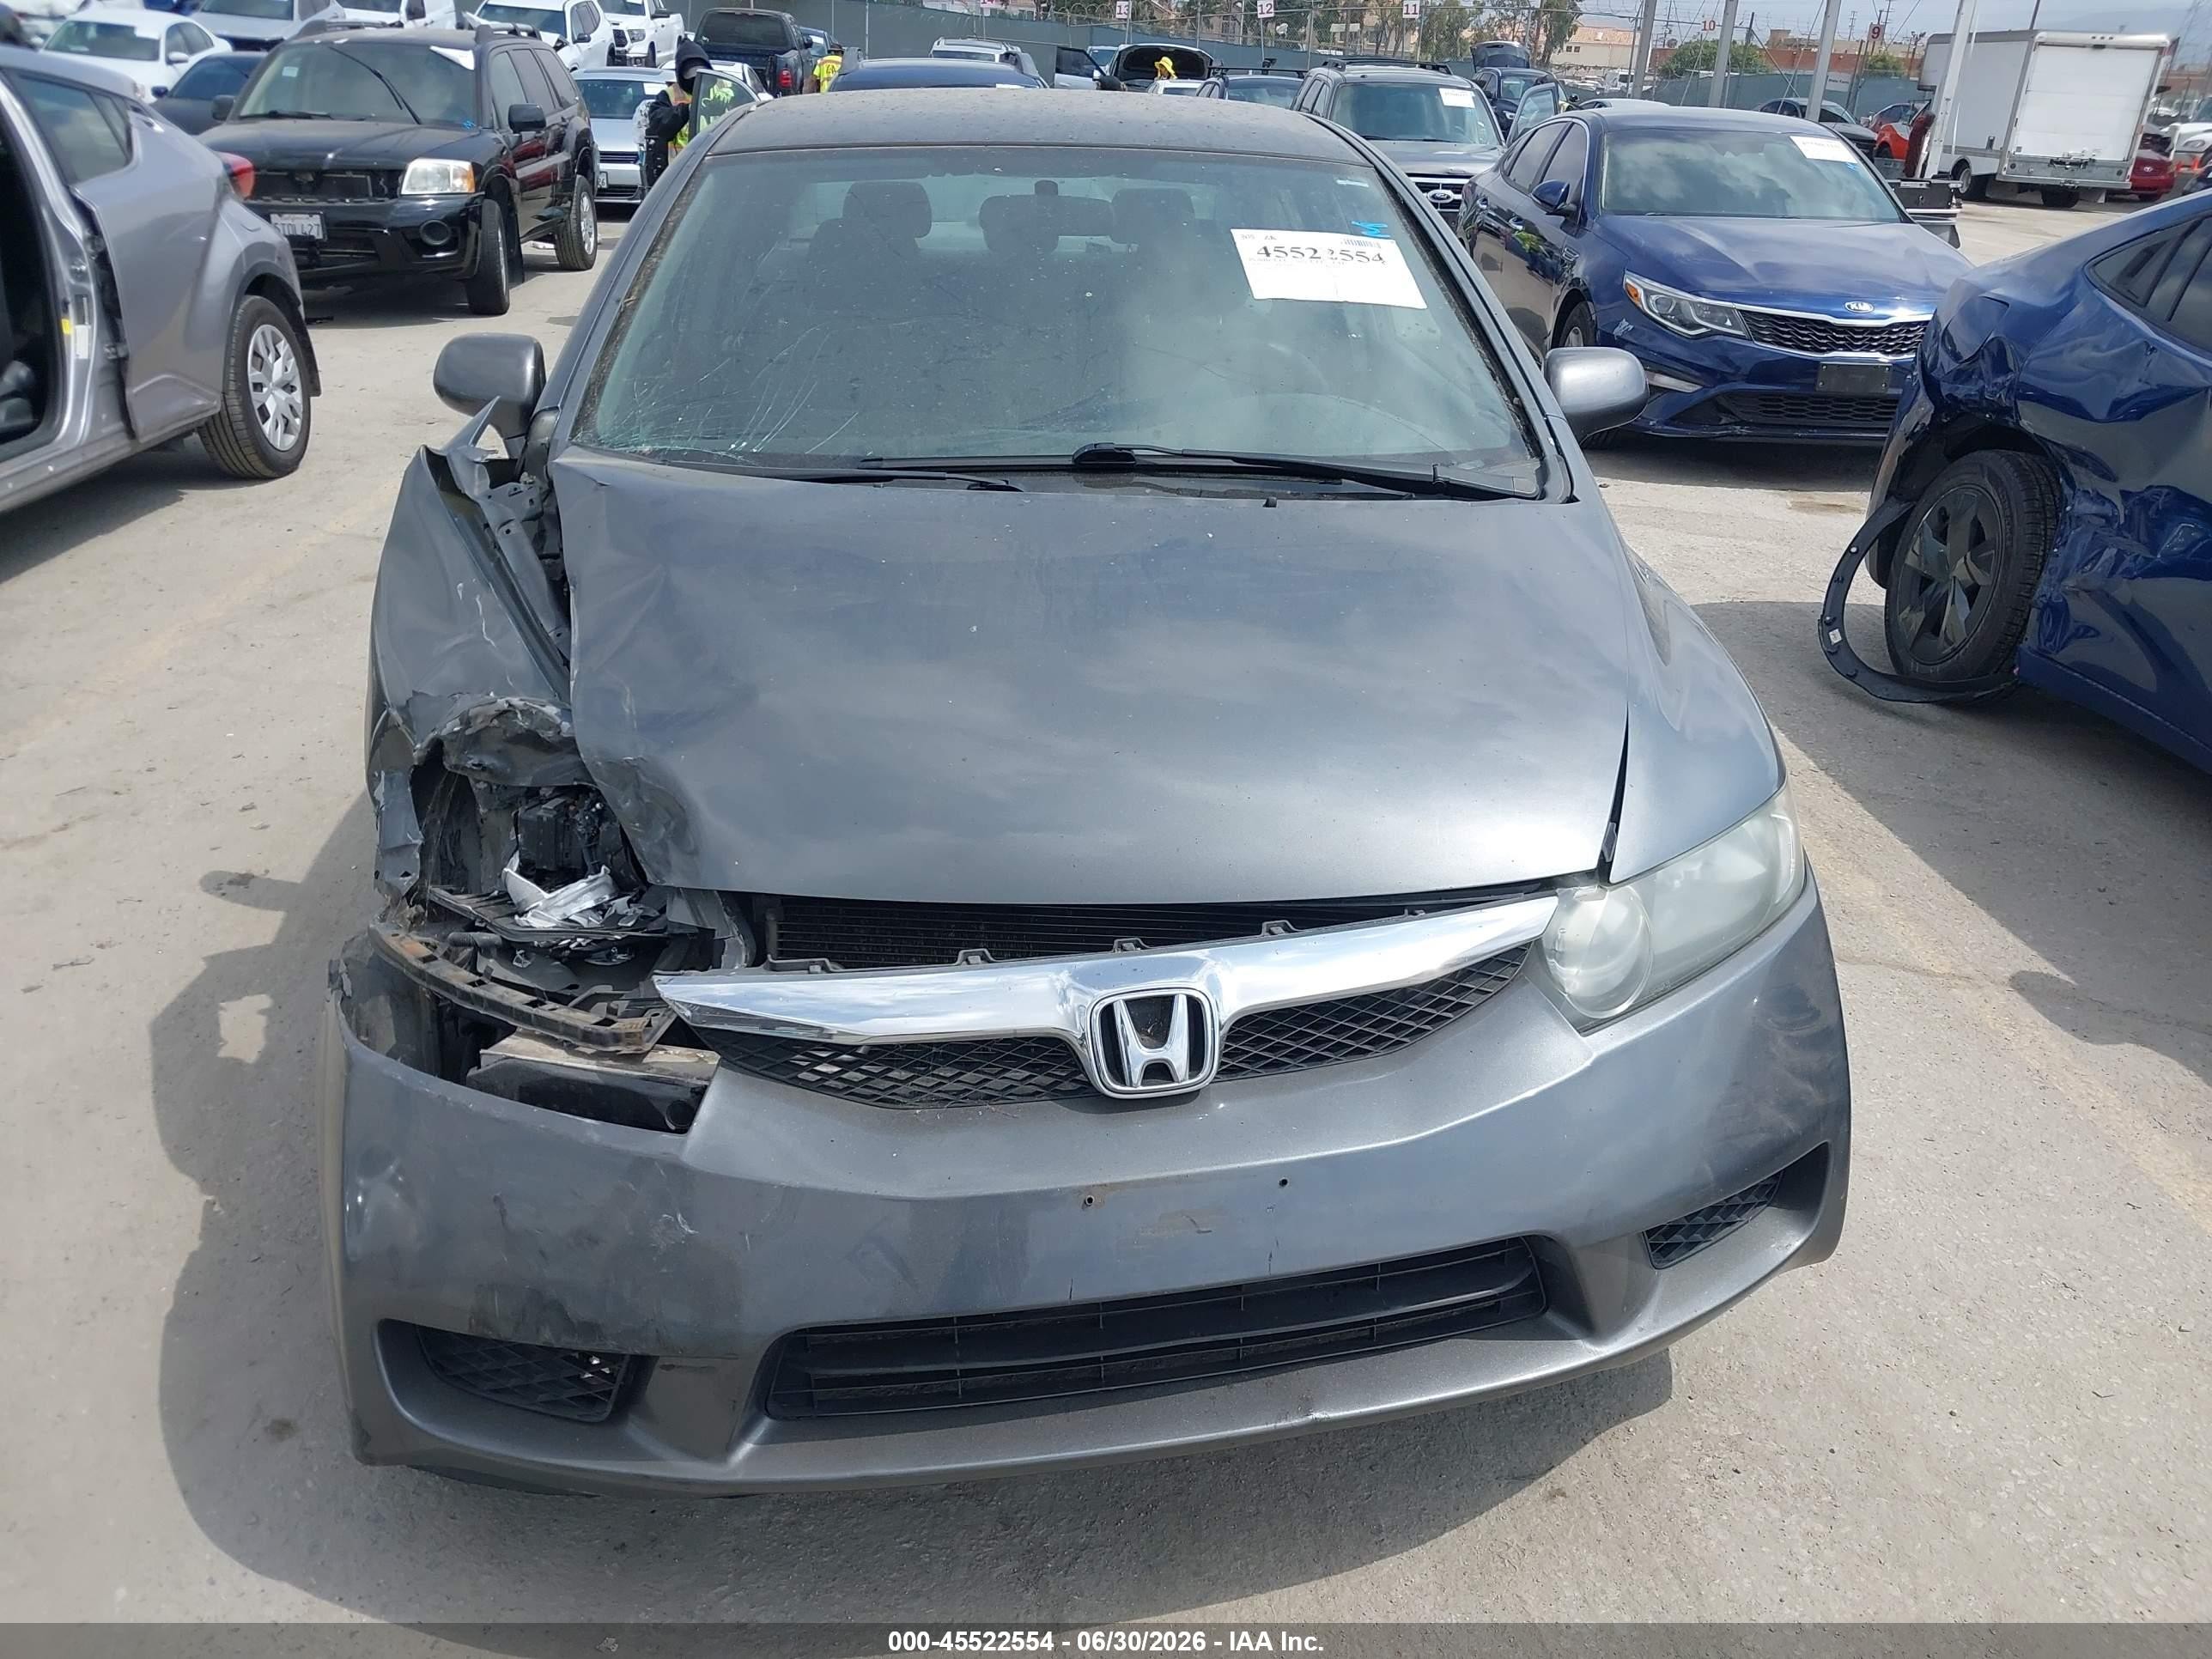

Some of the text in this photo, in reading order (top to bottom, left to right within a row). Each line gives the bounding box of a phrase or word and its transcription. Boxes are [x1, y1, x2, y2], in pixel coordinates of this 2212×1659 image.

[1258, 3, 1273, 15] 12
[1404, 3, 1418, 15] 11
[1701, 20, 1716, 31] 10
[1871, 26, 1881, 40] 9
[1257, 246, 1387, 264] 45522554
